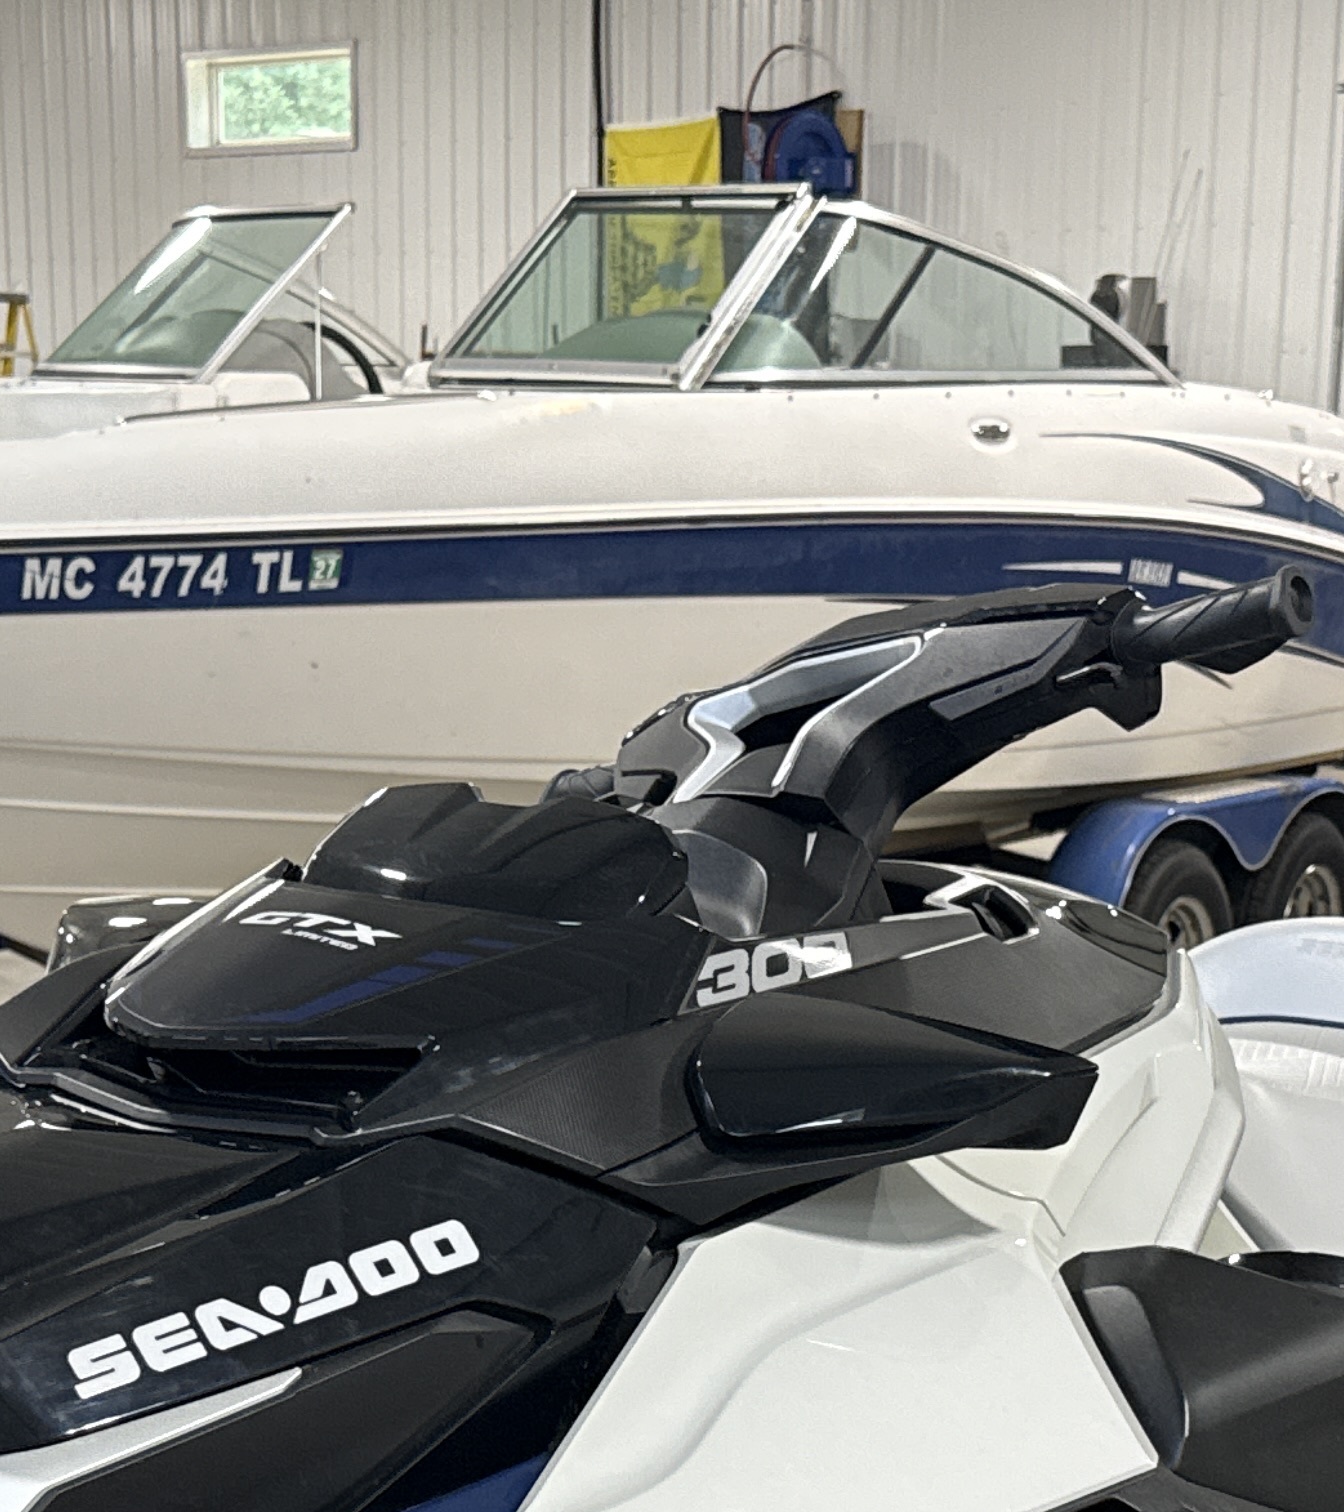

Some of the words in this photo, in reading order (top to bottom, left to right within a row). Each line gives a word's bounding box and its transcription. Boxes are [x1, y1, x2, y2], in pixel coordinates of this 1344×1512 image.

[21, 557, 96, 600] MC
[117, 552, 228, 599] 4774
[252, 550, 303, 594] TL
[238, 910, 404, 947] GTX
[696, 931, 853, 1008] 300
